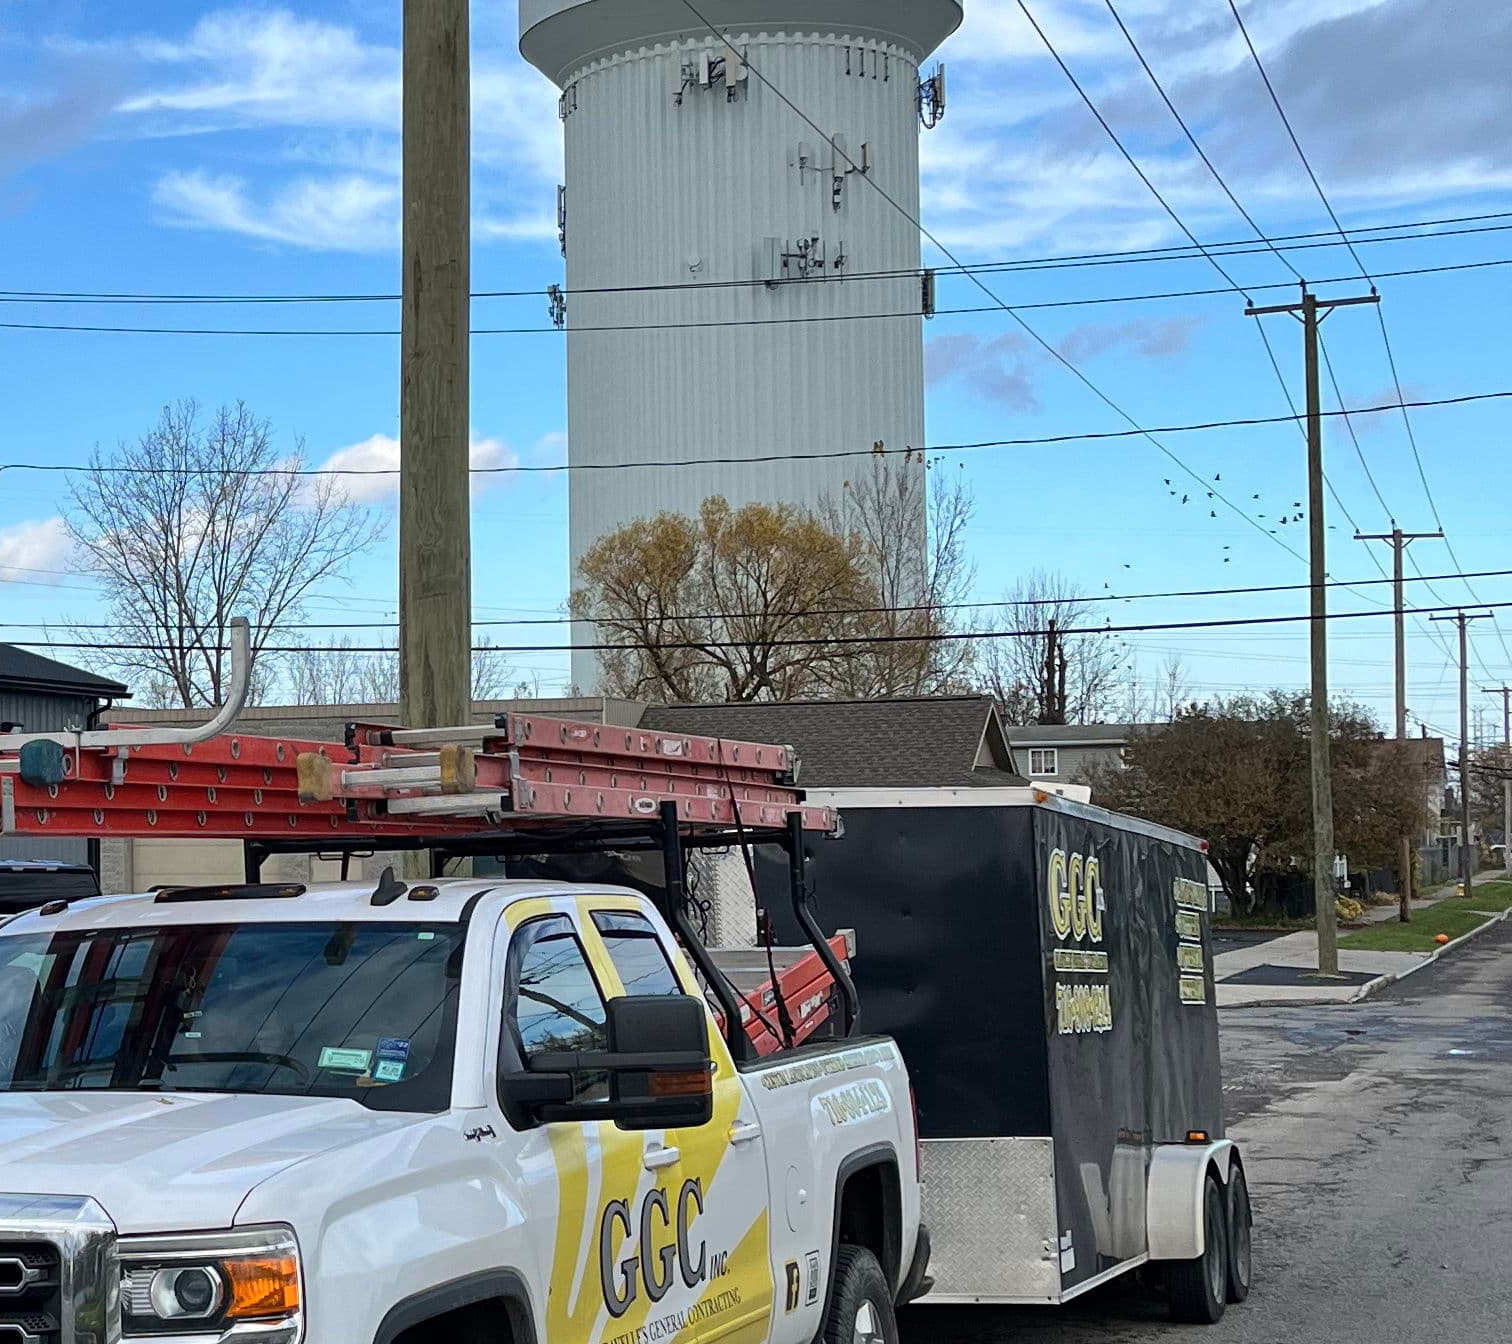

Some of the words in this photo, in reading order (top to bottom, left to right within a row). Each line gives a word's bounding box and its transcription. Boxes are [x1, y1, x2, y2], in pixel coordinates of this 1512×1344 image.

[599, 1176, 707, 1319] GGC
[649, 1310, 688, 1342] GENERAL
[687, 1287, 742, 1325] CONTRACTING
